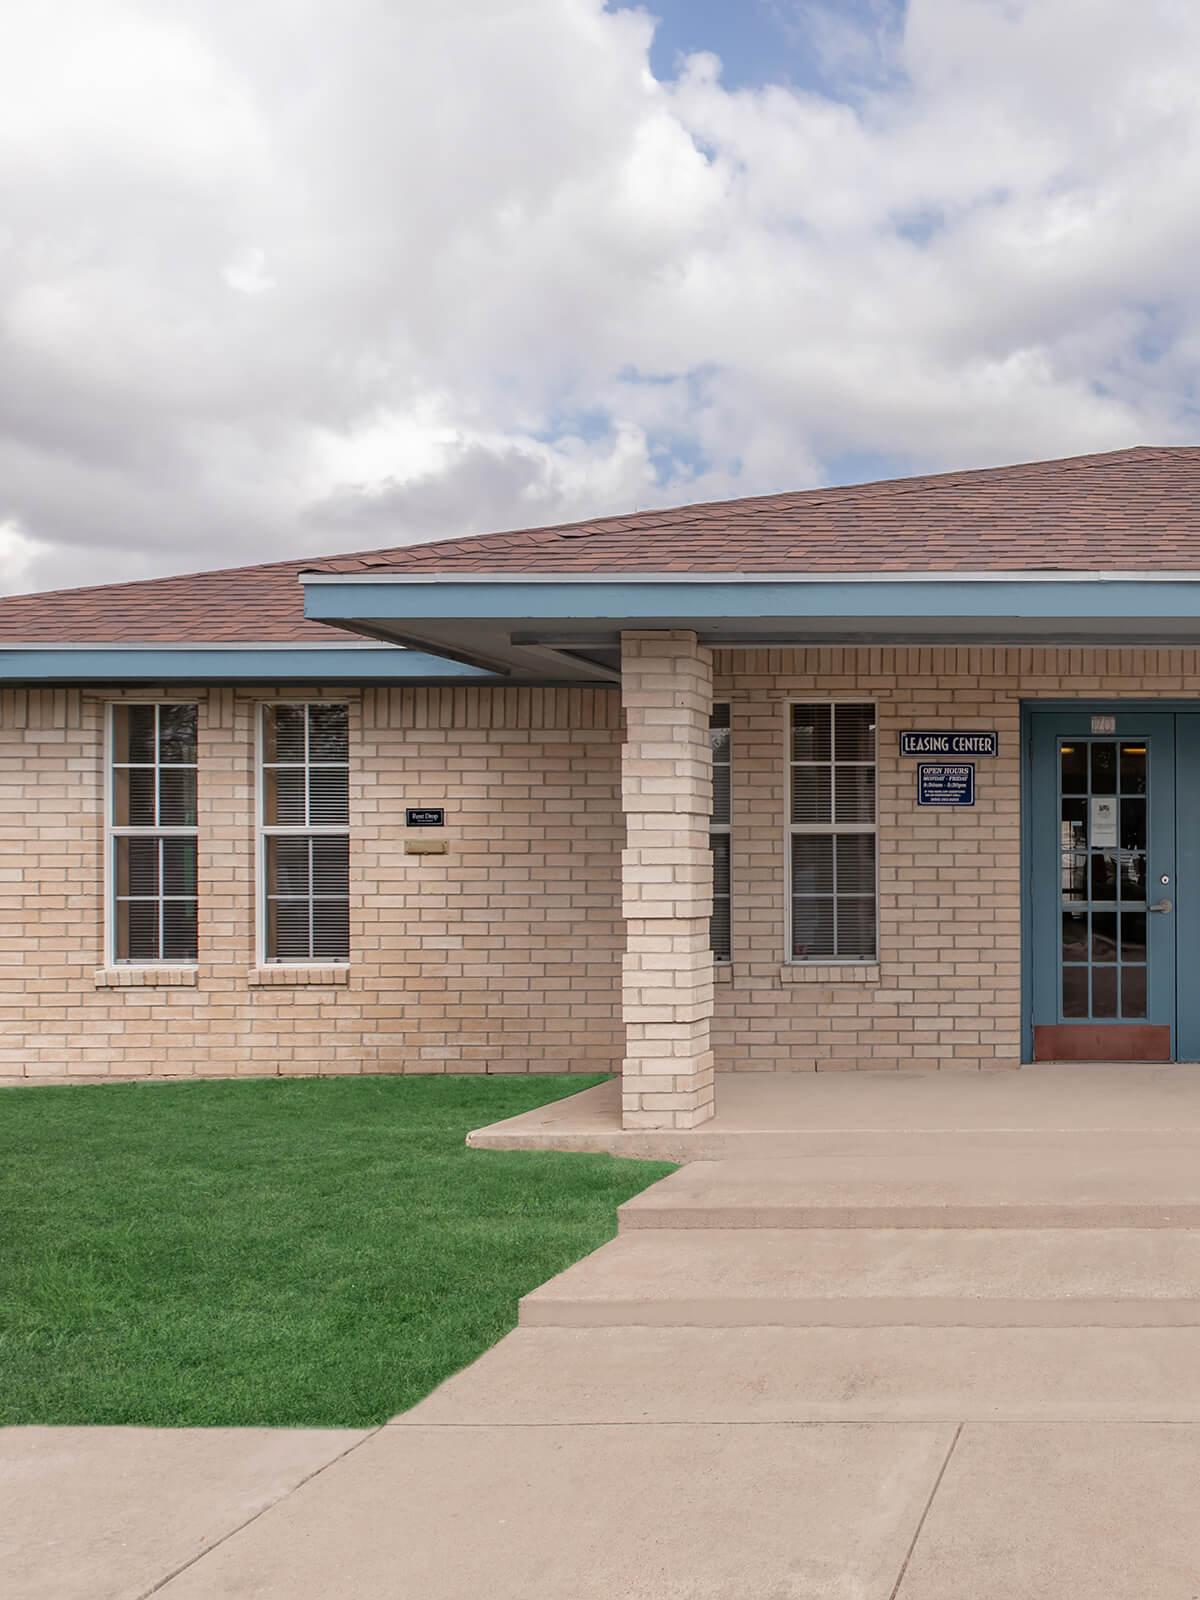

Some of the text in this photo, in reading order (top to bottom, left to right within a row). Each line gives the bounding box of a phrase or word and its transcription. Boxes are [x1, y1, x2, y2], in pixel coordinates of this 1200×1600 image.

[904, 737, 992, 751] LEASING CENTER
[425, 813, 438, 821] Drop
